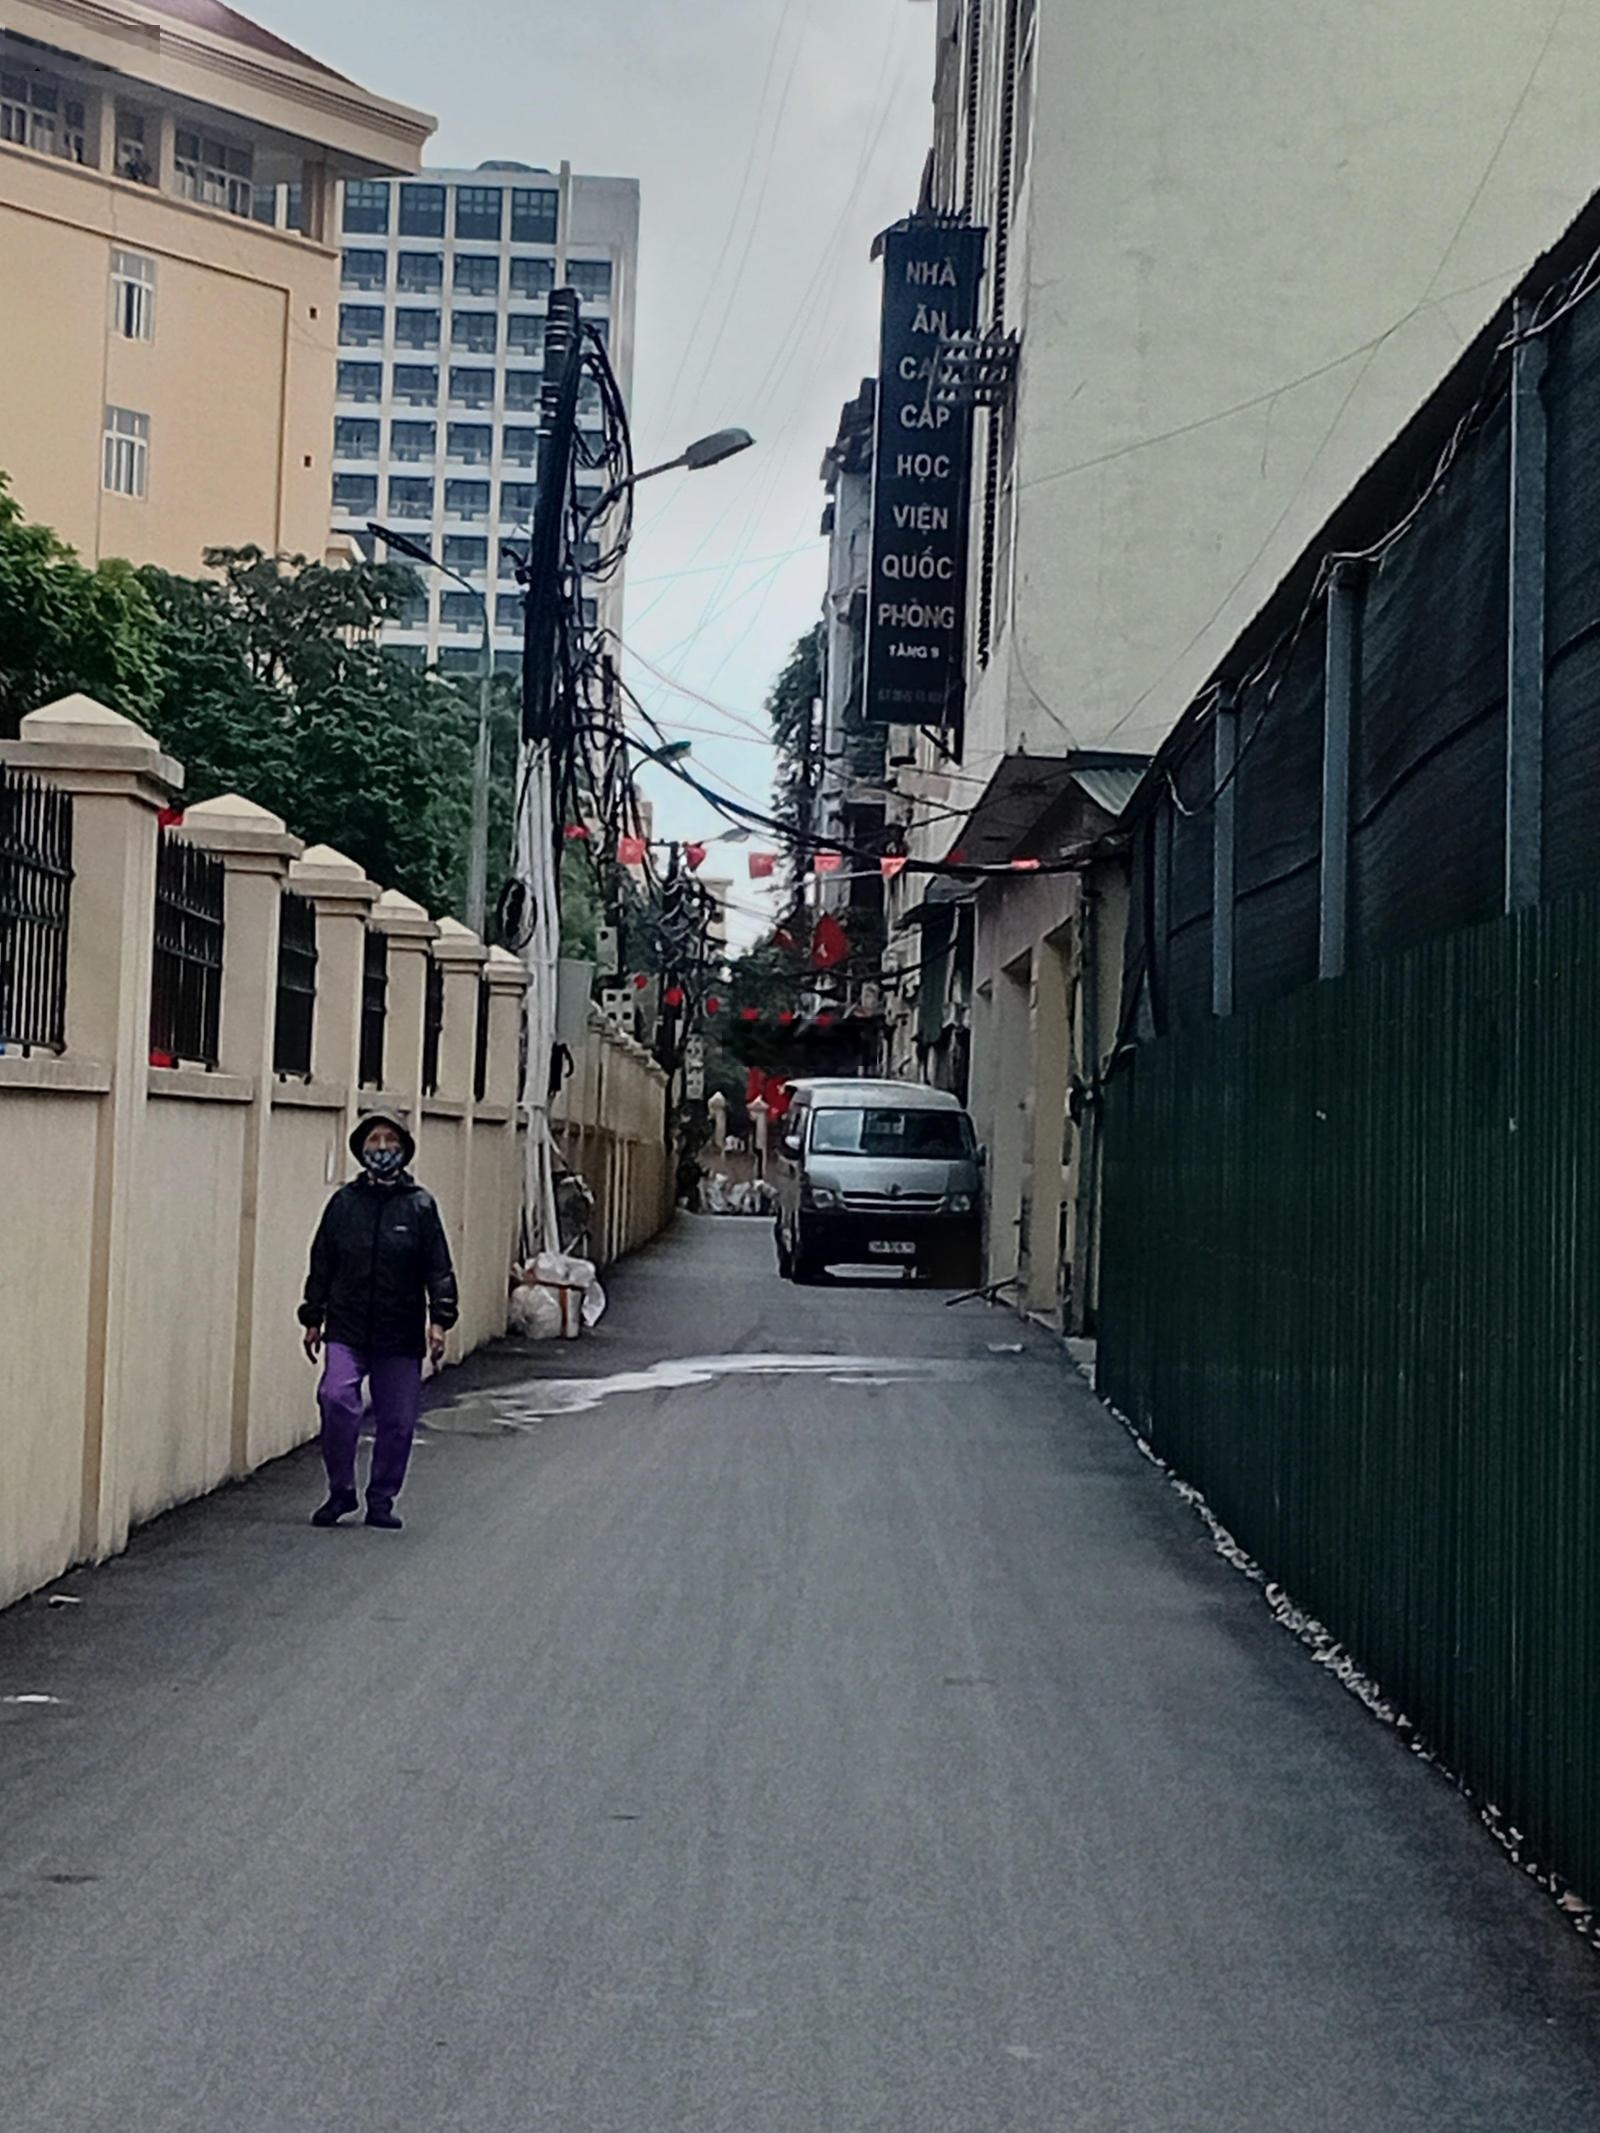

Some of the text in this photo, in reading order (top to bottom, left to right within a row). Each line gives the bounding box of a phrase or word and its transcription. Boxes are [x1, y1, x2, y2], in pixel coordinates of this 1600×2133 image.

[906, 256, 957, 287] NHÀ
[911, 303, 947, 337] ĂN
[897, 455, 950, 483] HỌC
[893, 502, 949, 536] VIỆN
[881, 546, 953, 580] QUỐC
[877, 598, 955, 629] PHÒNG
